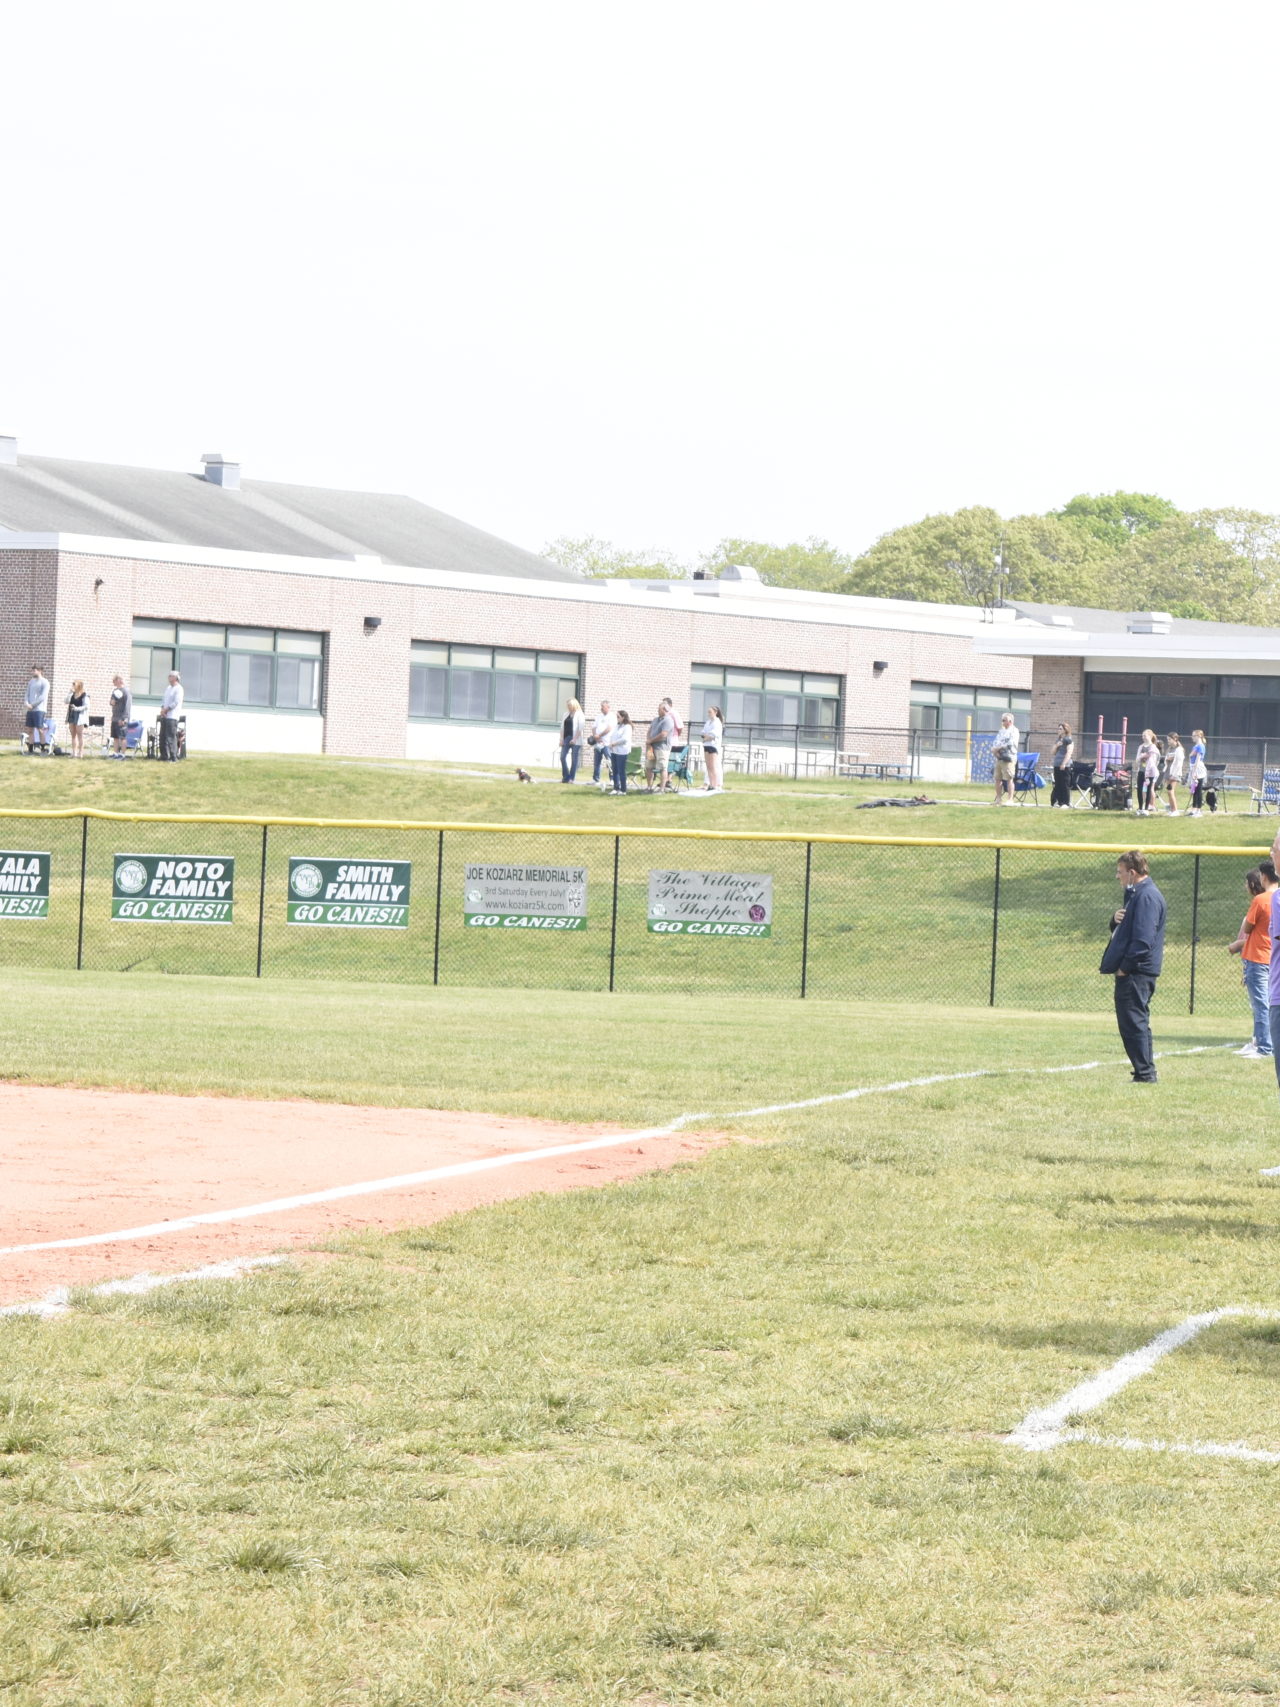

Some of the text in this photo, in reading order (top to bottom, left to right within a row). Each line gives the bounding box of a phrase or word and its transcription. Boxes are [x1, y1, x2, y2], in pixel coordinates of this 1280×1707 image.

[0, 857, 40, 875] ALA
[156, 861, 225, 880] NOTO
[336, 865, 394, 883] SMITH
[466, 867, 584, 883] JOE KOZIARZ MEMORIAL 5K
[149, 879, 231, 897] FAMILY
[657, 872, 761, 892] The Village
[325, 883, 405, 901] FAMILY
[484, 886, 497, 896] 3rd
[498, 886, 529, 898] Saturday
[529, 887, 548, 898] Every
[656, 886, 765, 903] Prime Meat
[118, 901, 229, 919] GO CANES!!
[294, 905, 405, 923] GO CANES!!
[485, 899, 565, 911] www.koziarz5k.com
[675, 901, 744, 920] Shoppe
[469, 915, 582, 929] GO CANES!!
[652, 921, 766, 936] GO CANES!!
